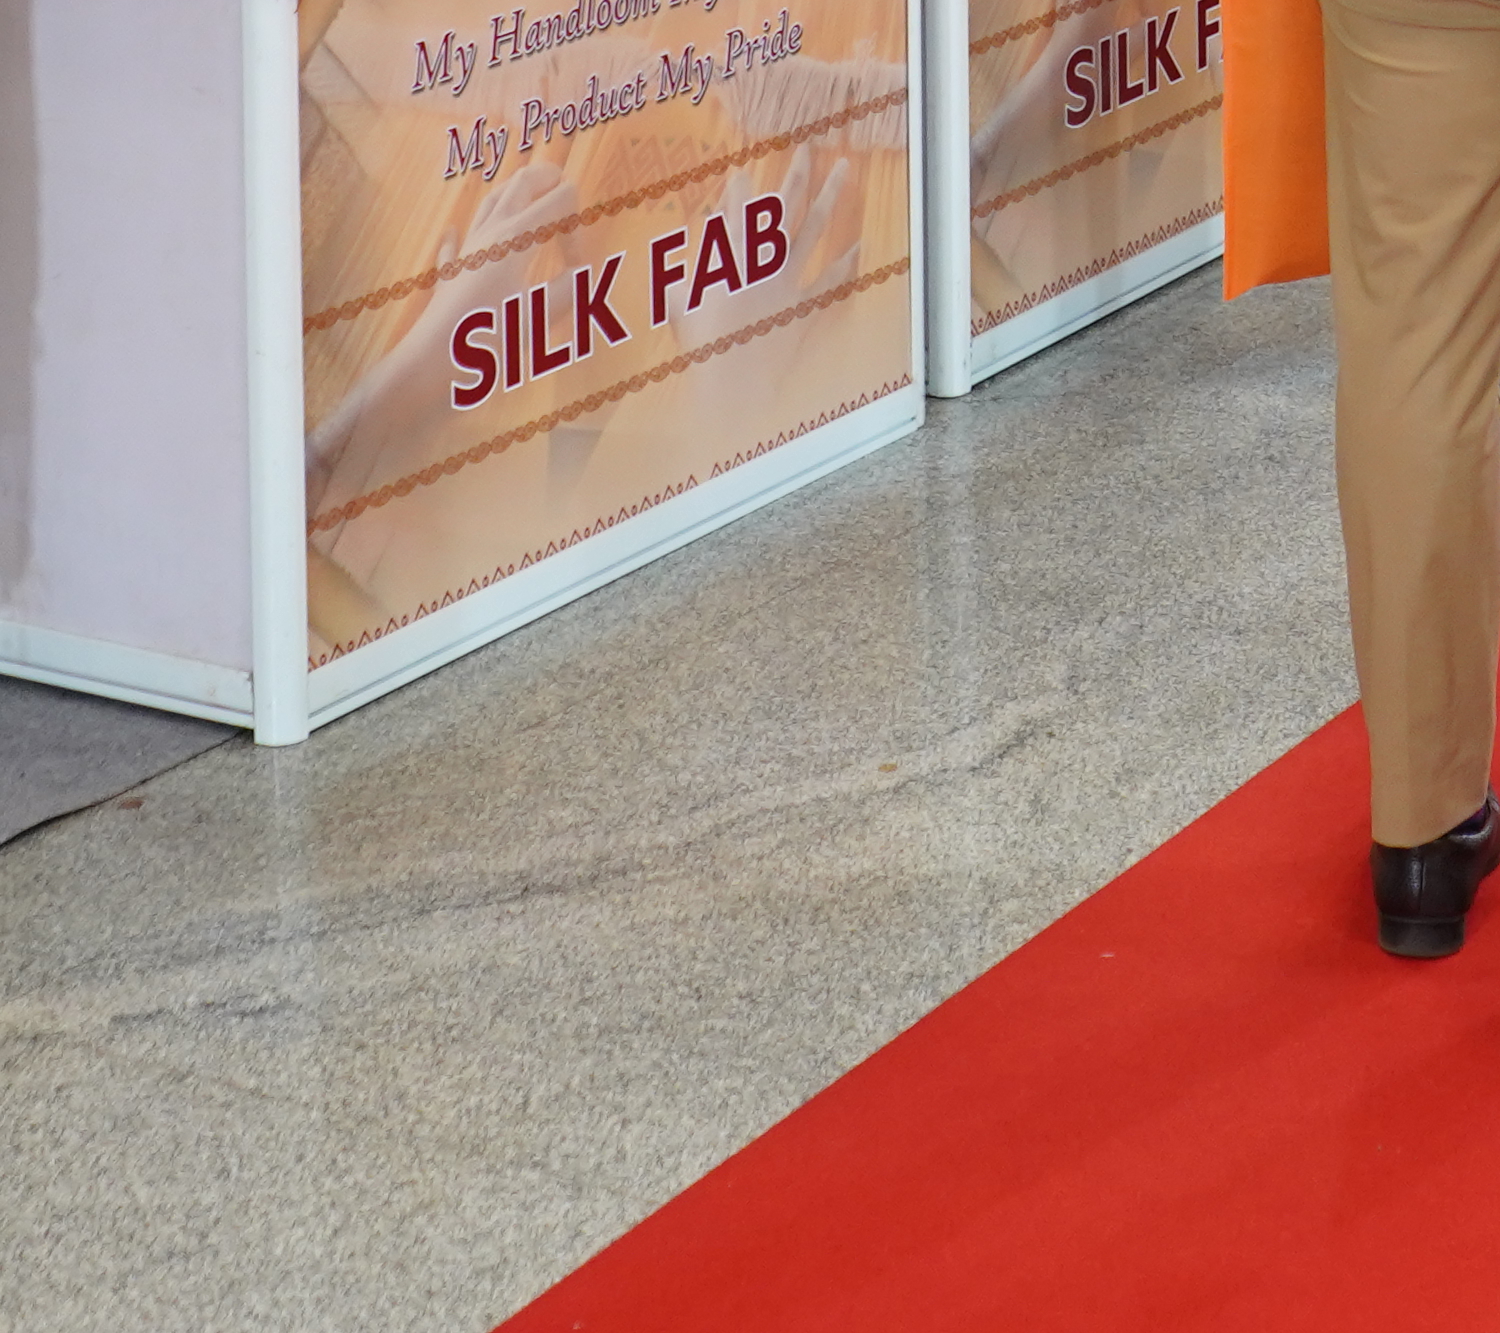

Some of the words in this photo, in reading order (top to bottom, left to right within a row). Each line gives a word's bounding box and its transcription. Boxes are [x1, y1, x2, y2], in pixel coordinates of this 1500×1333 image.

[411, 31, 477, 91] My
[442, 116, 508, 180] My
[519, 69, 647, 151] Product
[655, 44, 714, 103] My
[723, 9, 804, 80] Pride
[1063, 7, 1184, 131] SILK
[450, 250, 633, 412] SILK
[649, 192, 791, 328] FAB
